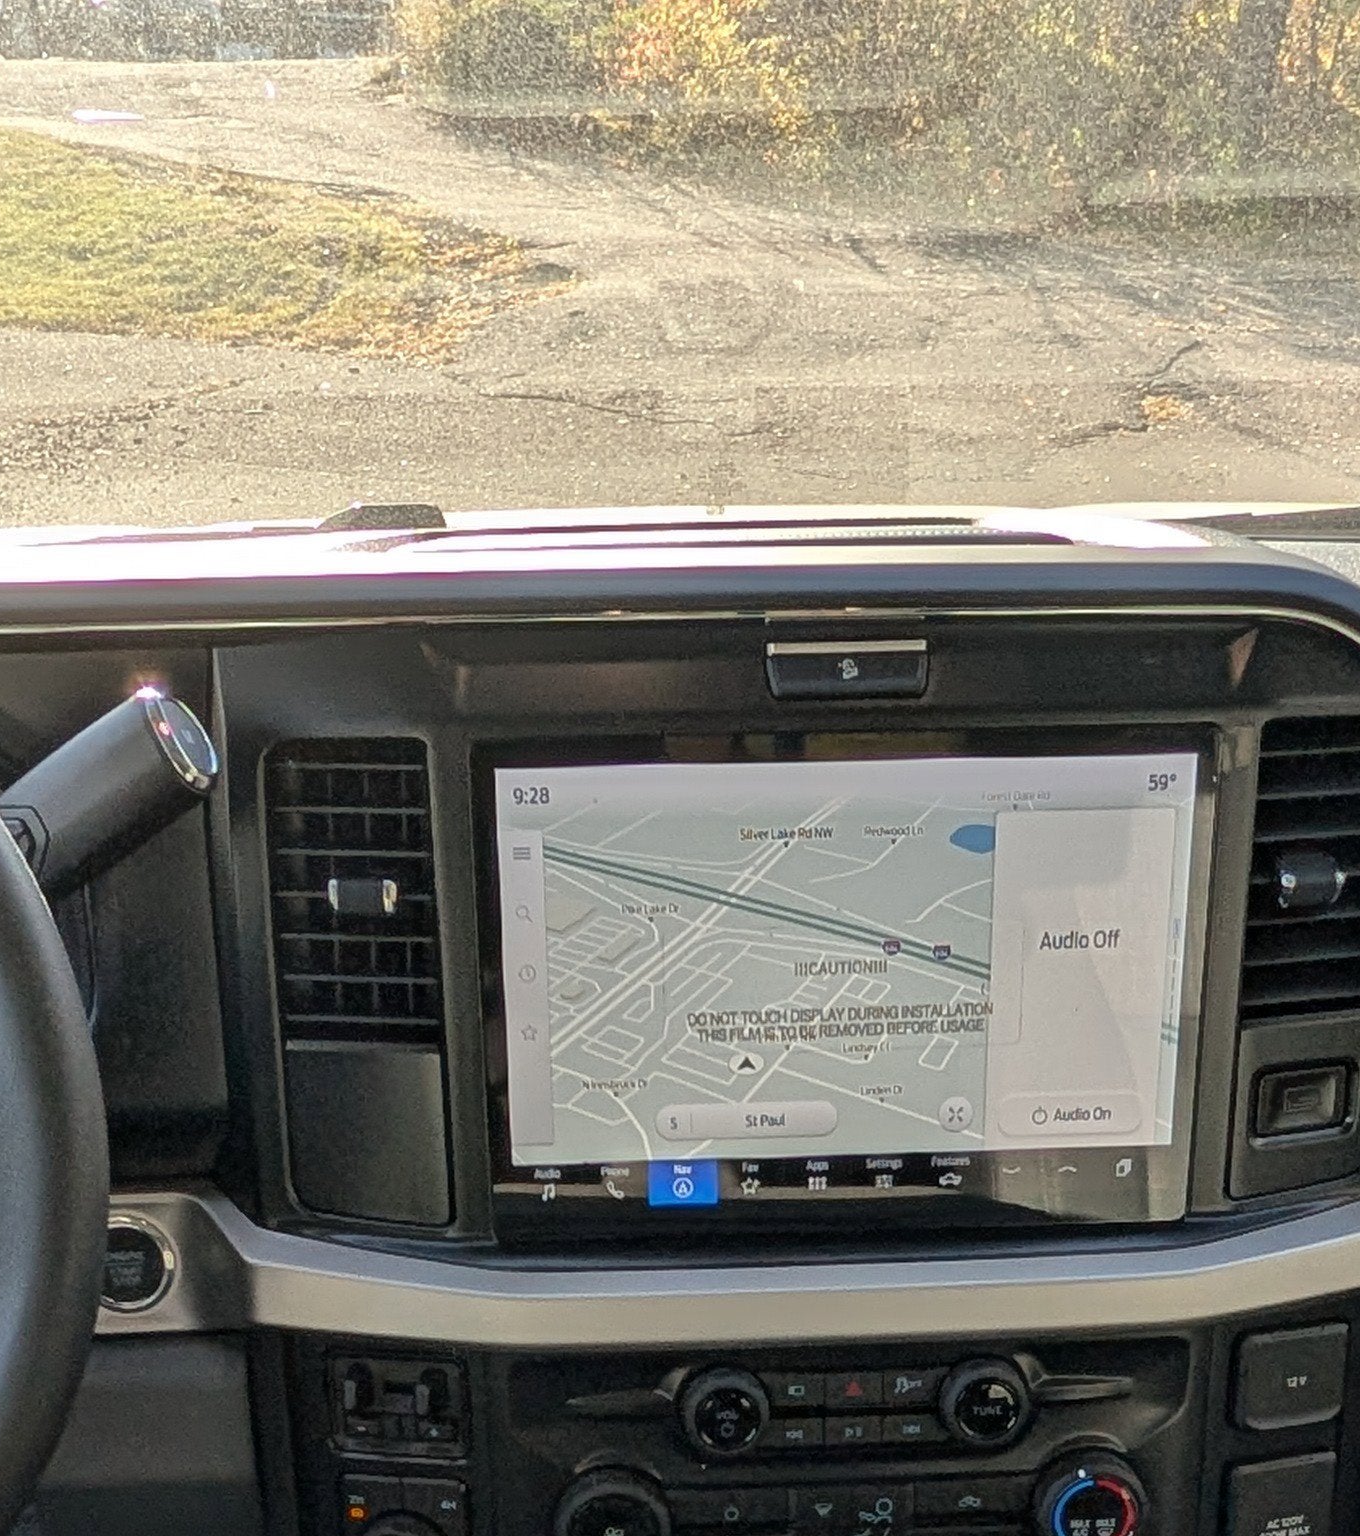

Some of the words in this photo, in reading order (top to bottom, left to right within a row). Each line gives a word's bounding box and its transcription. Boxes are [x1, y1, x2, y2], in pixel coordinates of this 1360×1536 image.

[1148, 773, 1177, 792] 59°
[513, 787, 550, 804] 9:28
[740, 828, 768, 841] Silver
[770, 828, 796, 840] Lake
[798, 827, 813, 839] Rd
[815, 827, 833, 838] NW
[1039, 931, 1089, 950] Audio
[1093, 929, 1121, 948] Off
[687, 1012, 707, 1027] DO
[710, 1011, 737, 1026] NOT
[741, 1010, 787, 1025] TOUCH
[791, 1007, 845, 1023] DISPLAY
[848, 1005, 899, 1021] DURING
[901, 1002, 993, 1019] INSTALLATION
[819, 1022, 884, 1039] REMOVED
[887, 1021, 938, 1035] BEFORE
[941, 1019, 985, 1033] USAGE
[745, 1116, 759, 1128] St
[760, 1114, 785, 1127] Paul
[1053, 1108, 1090, 1121] Audio
[1093, 1107, 1112, 1120] On
